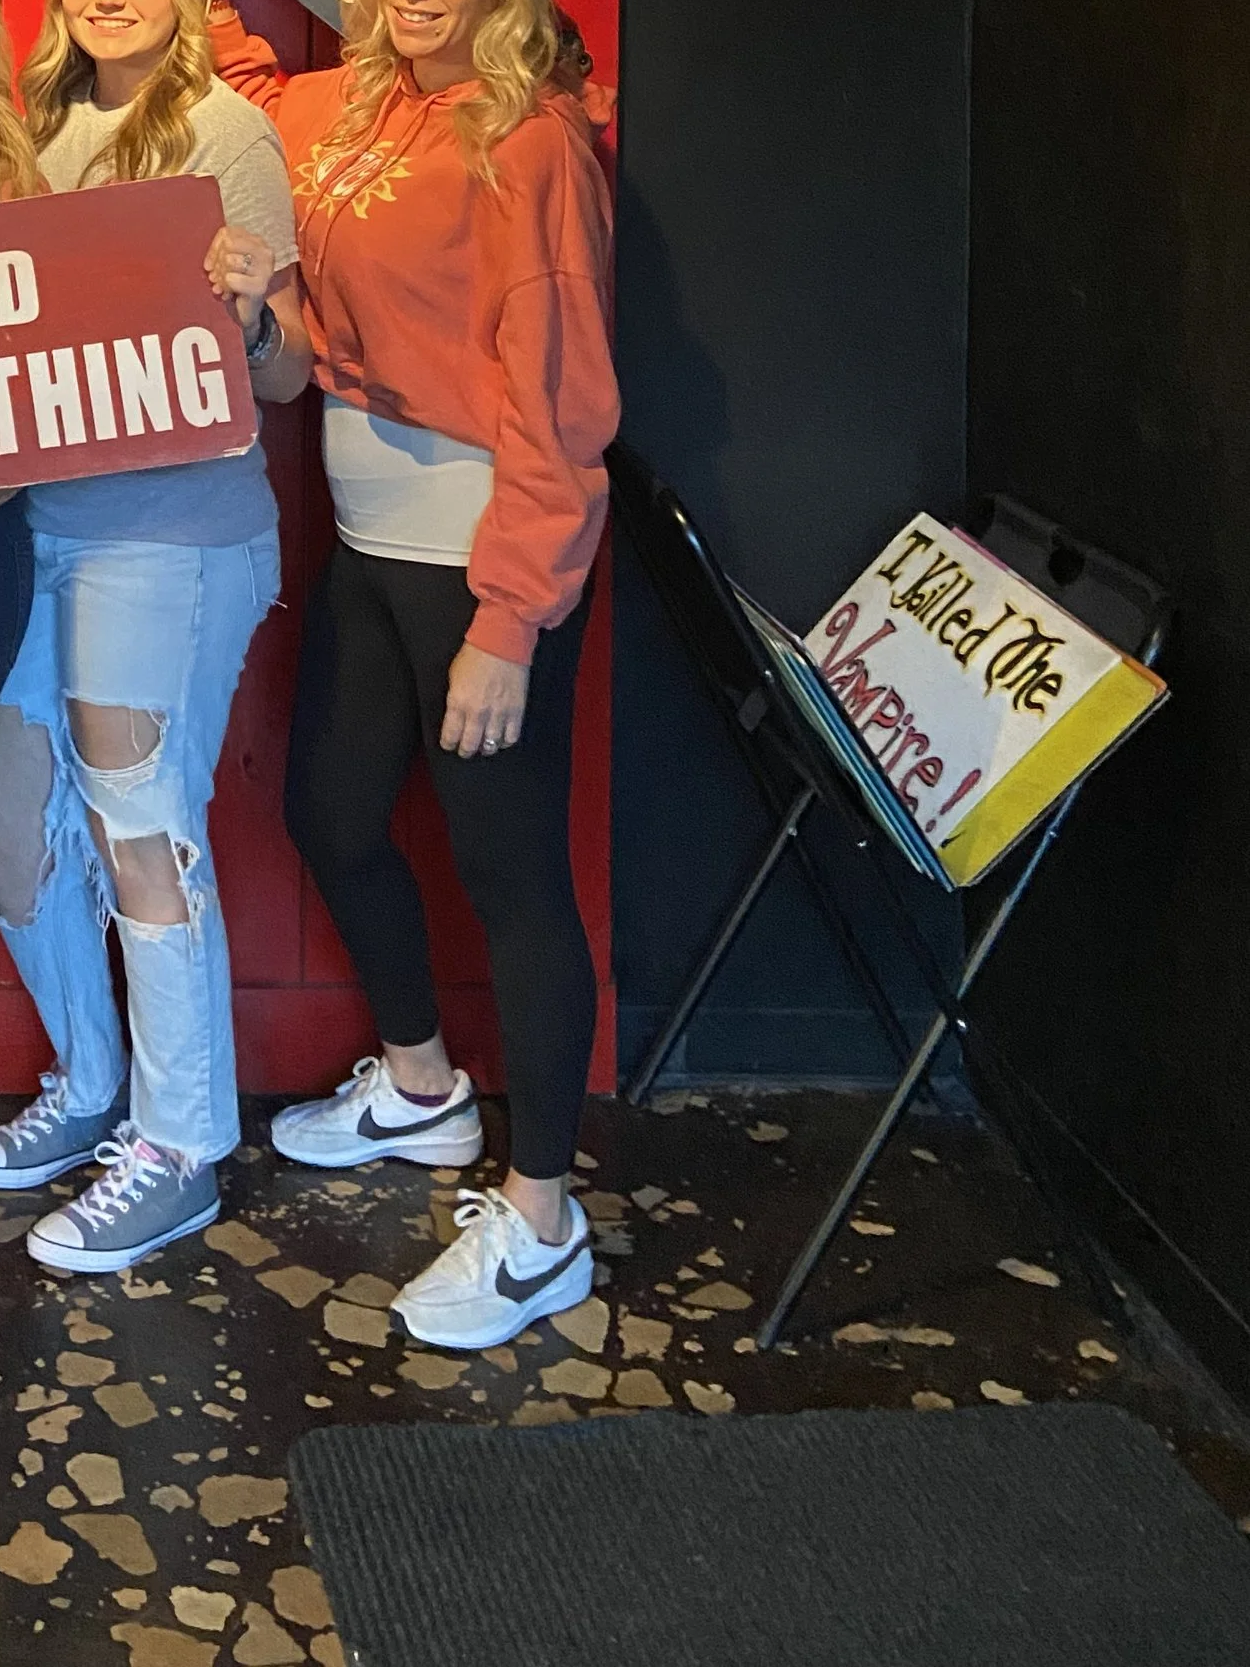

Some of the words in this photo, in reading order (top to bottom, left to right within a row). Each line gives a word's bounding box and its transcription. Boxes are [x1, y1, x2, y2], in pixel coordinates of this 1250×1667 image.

[880, 529, 934, 586] I
[889, 552, 1016, 666] Killed
[984, 617, 1066, 714] The
